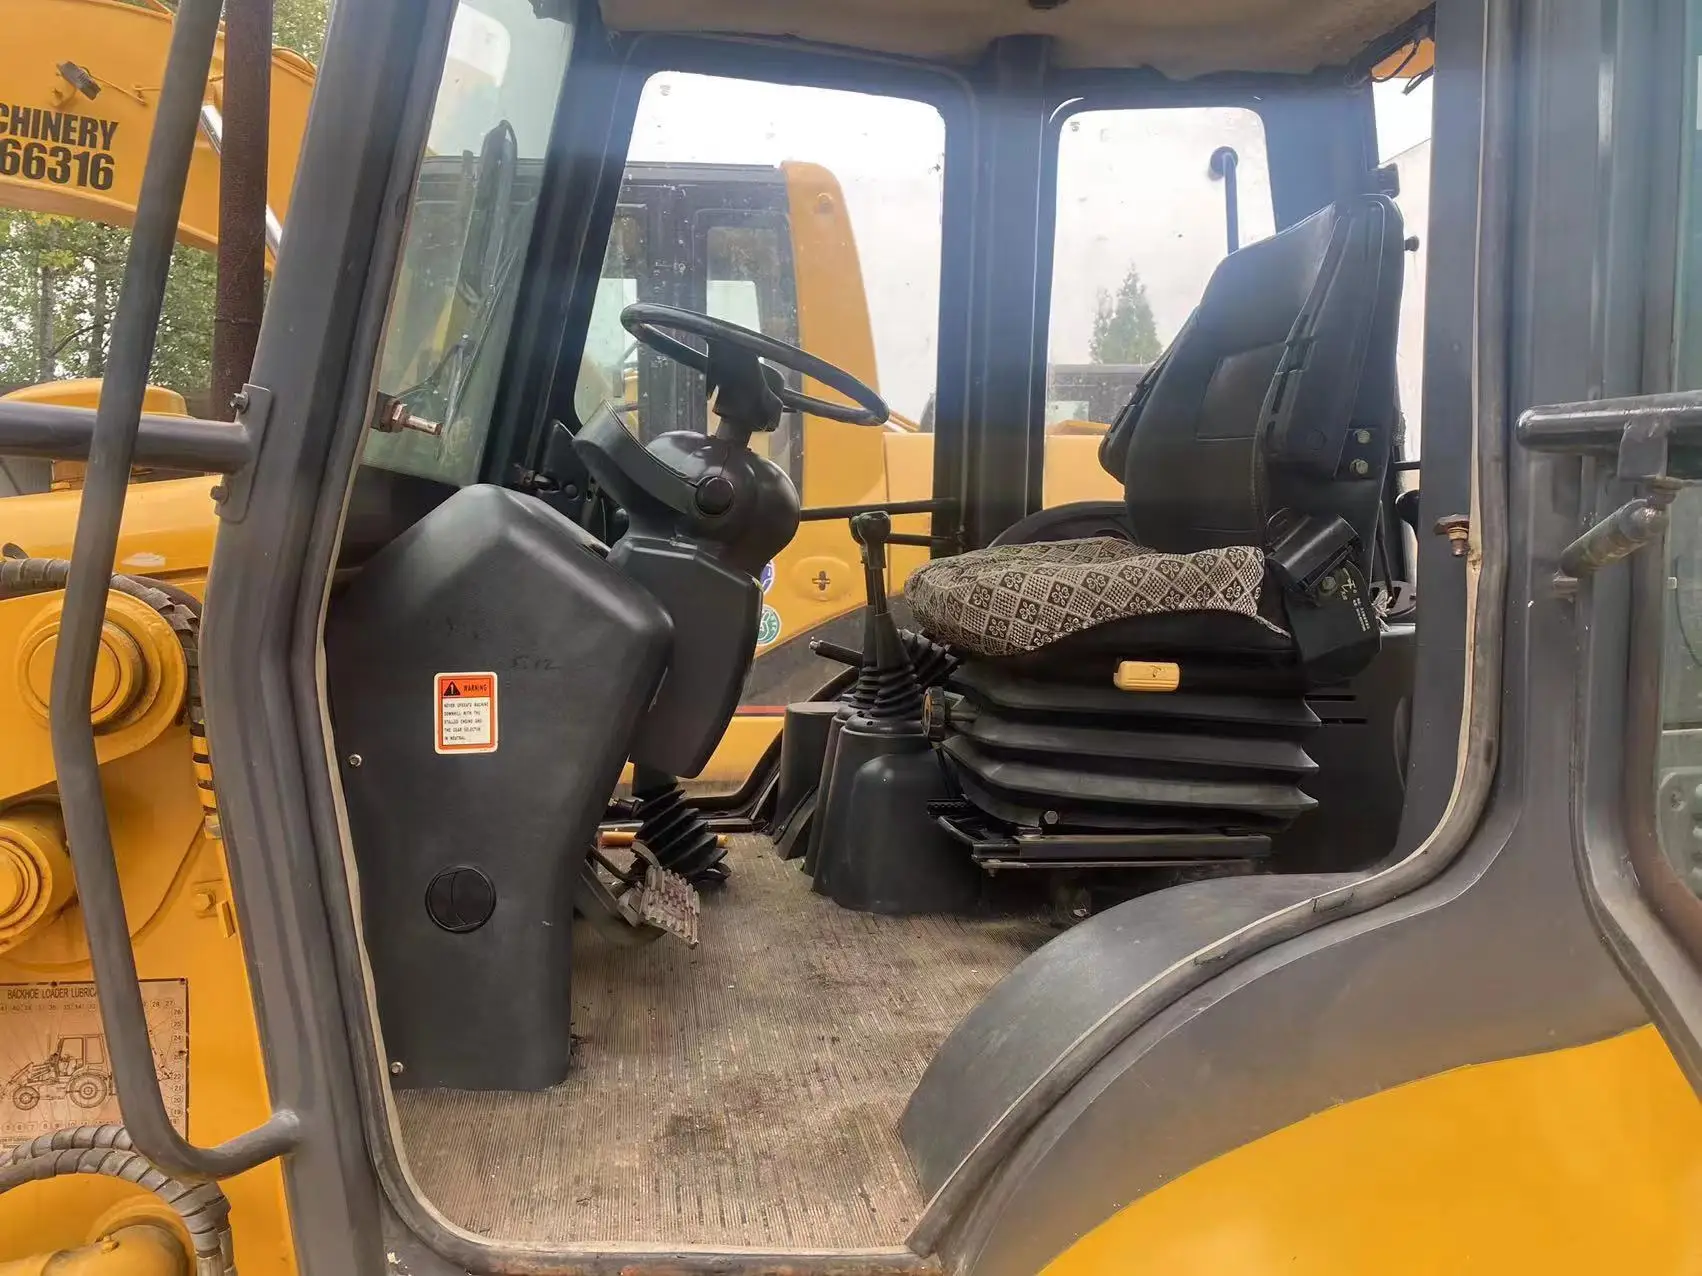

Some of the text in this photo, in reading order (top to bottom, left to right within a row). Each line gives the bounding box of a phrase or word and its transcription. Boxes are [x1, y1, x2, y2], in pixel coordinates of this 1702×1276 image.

[0, 138, 115, 190] 66316
[463, 683, 488, 692] WARNING
[7, 988, 39, 1000] BACKHOE
[42, 987, 69, 999] LOADER
